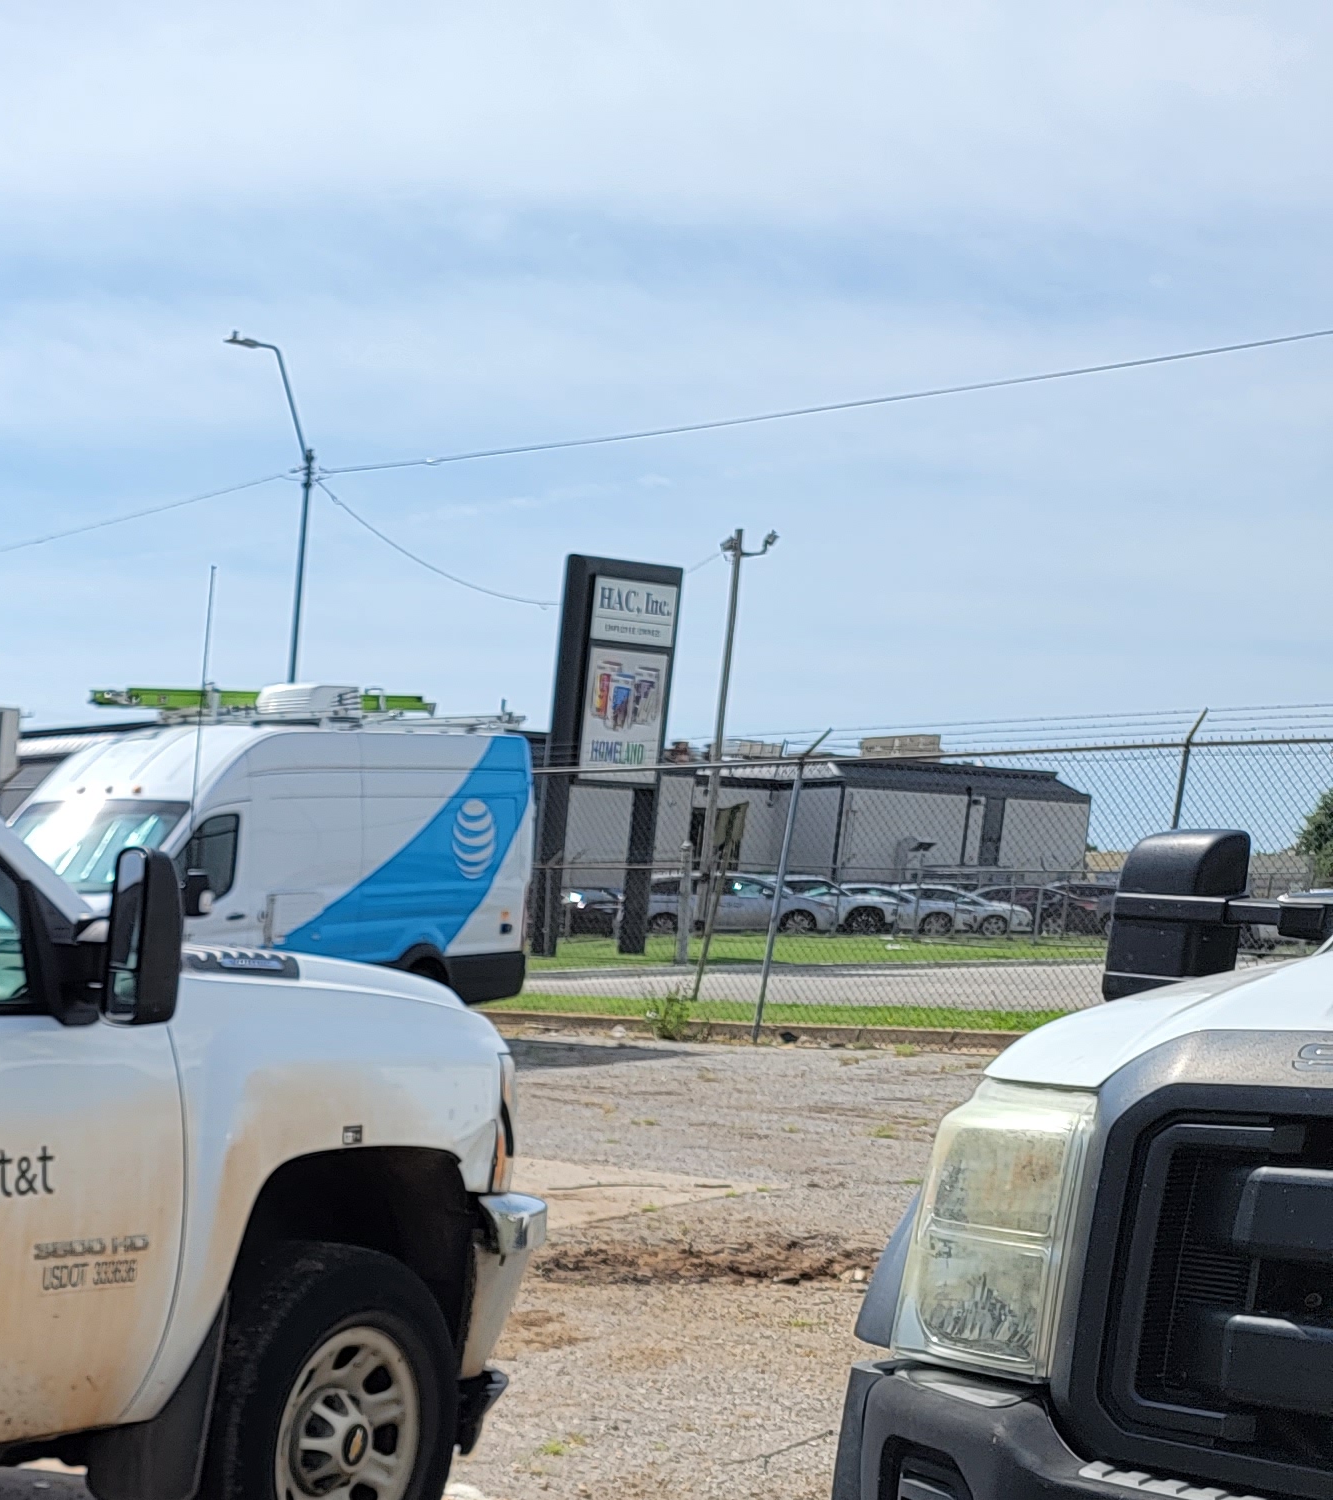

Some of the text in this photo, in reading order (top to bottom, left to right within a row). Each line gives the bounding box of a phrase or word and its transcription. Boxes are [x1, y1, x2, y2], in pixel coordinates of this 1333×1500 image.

[598, 586, 673, 617] HAC, Inc.
[589, 739, 645, 766] HOMELAND
[42, 1262, 89, 1291] USDOT
